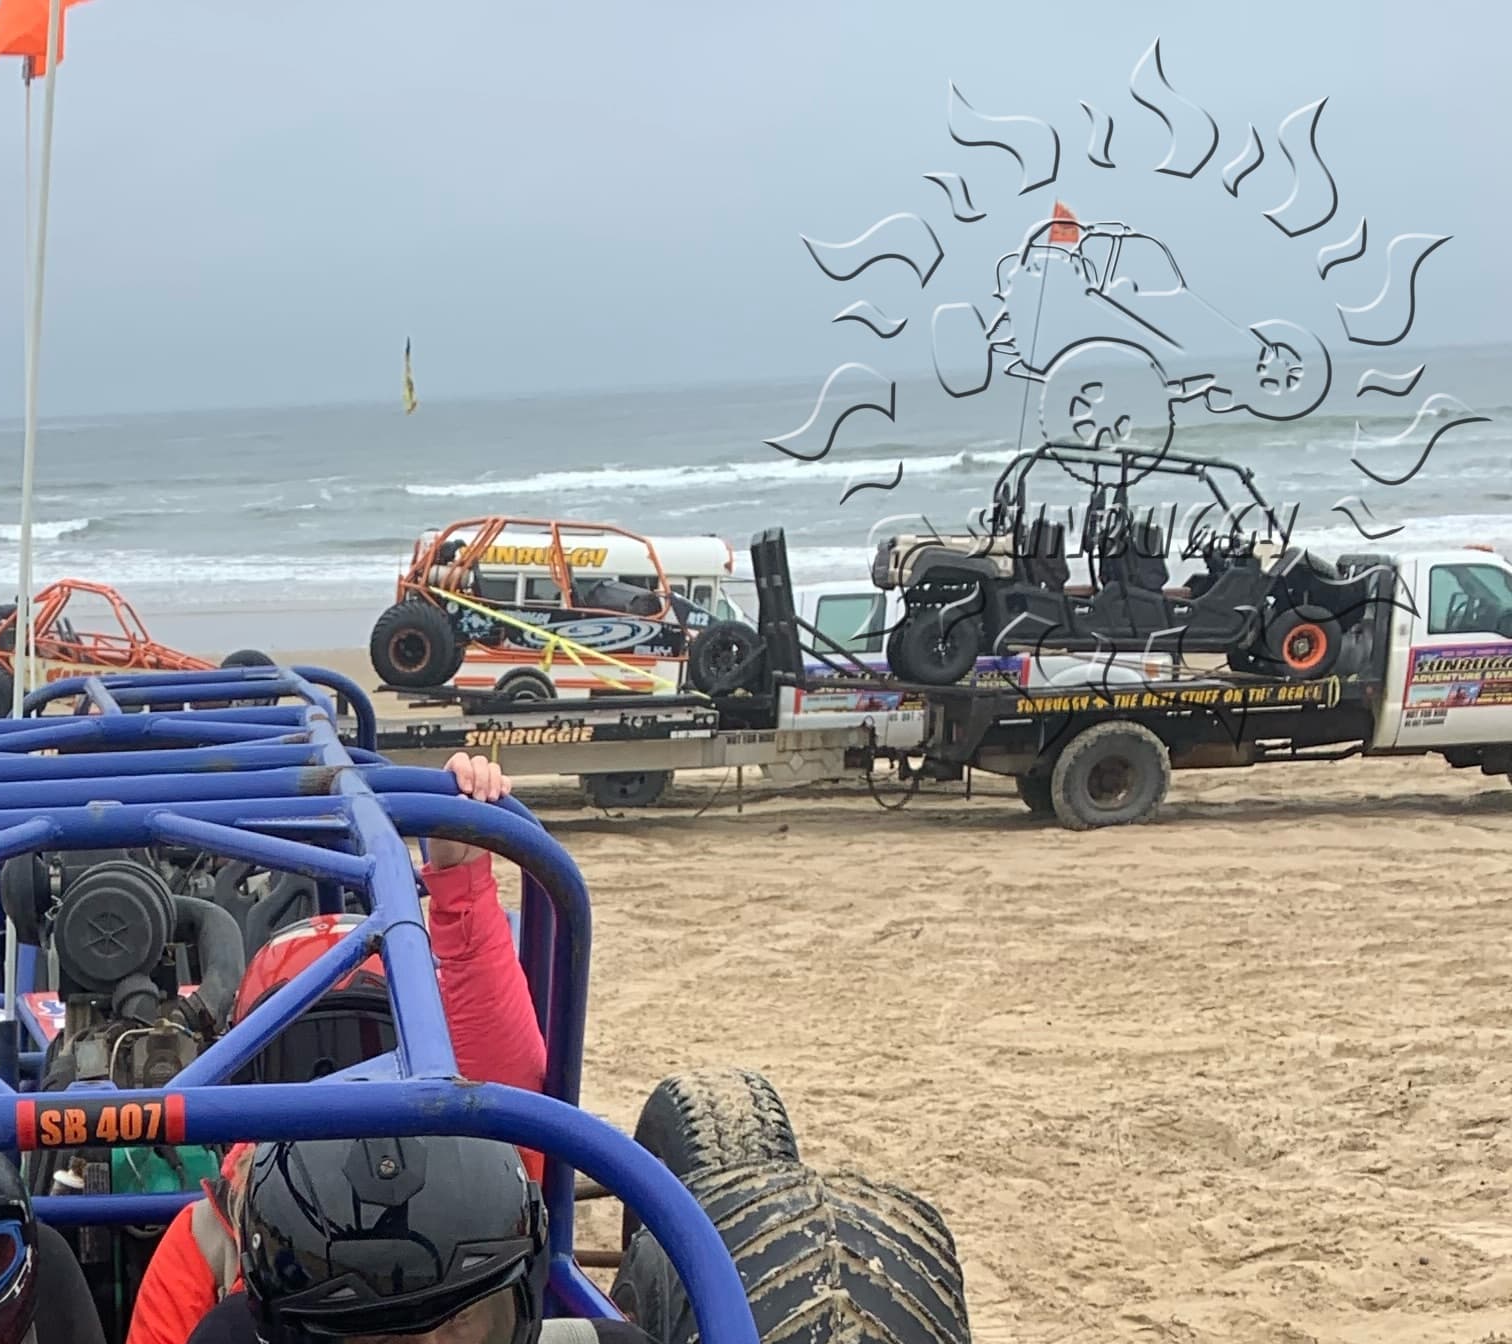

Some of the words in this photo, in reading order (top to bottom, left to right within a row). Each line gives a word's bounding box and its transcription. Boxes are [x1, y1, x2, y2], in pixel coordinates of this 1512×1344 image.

[1416, 656, 1512, 673] SUNBUGG
[1016, 696, 1089, 713] SUNBUGGY
[1113, 693, 1137, 708] THE
[1180, 689, 1219, 705] STUFF
[1223, 687, 1243, 702] ON
[464, 726, 593, 747] SUNBUGGIE
[39, 1108, 88, 1146] SB
[96, 1102, 162, 1142] 407
